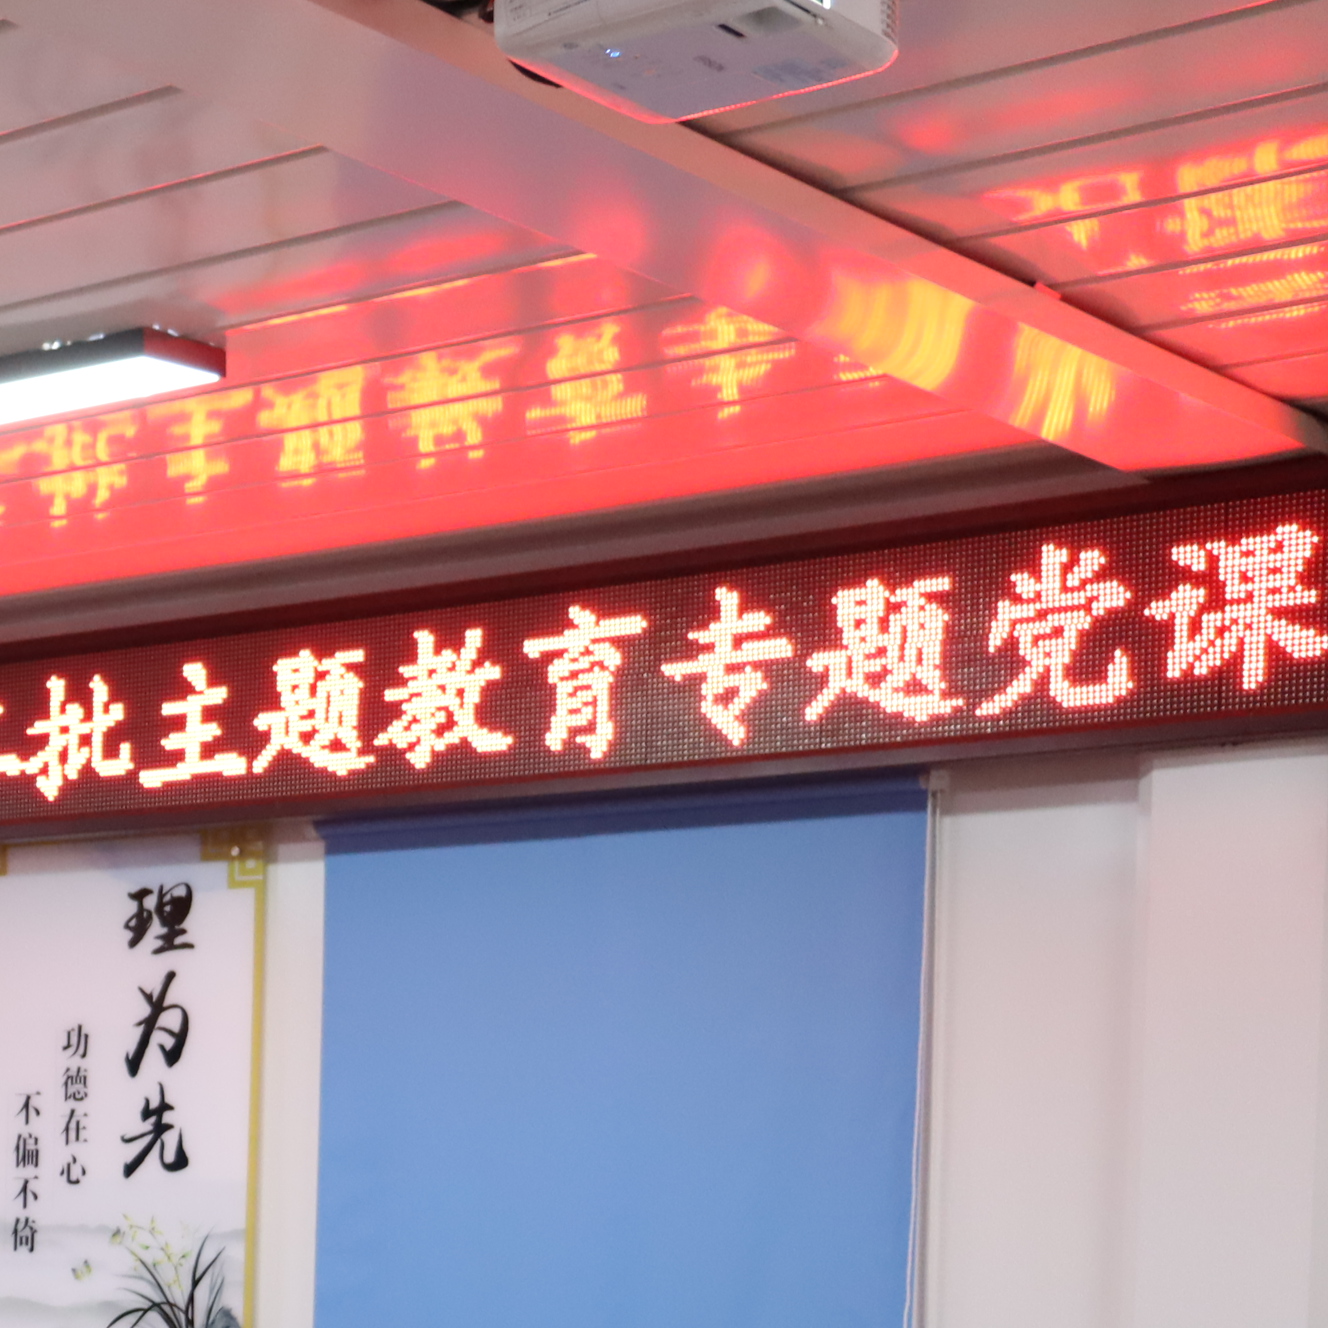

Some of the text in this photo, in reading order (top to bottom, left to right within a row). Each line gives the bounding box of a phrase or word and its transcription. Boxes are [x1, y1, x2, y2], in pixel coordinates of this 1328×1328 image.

[60, 1024, 89, 1186] 功德在心
[121, 881, 195, 1180] 理为先
[11, 1090, 41, 1253] 不偏不倚
